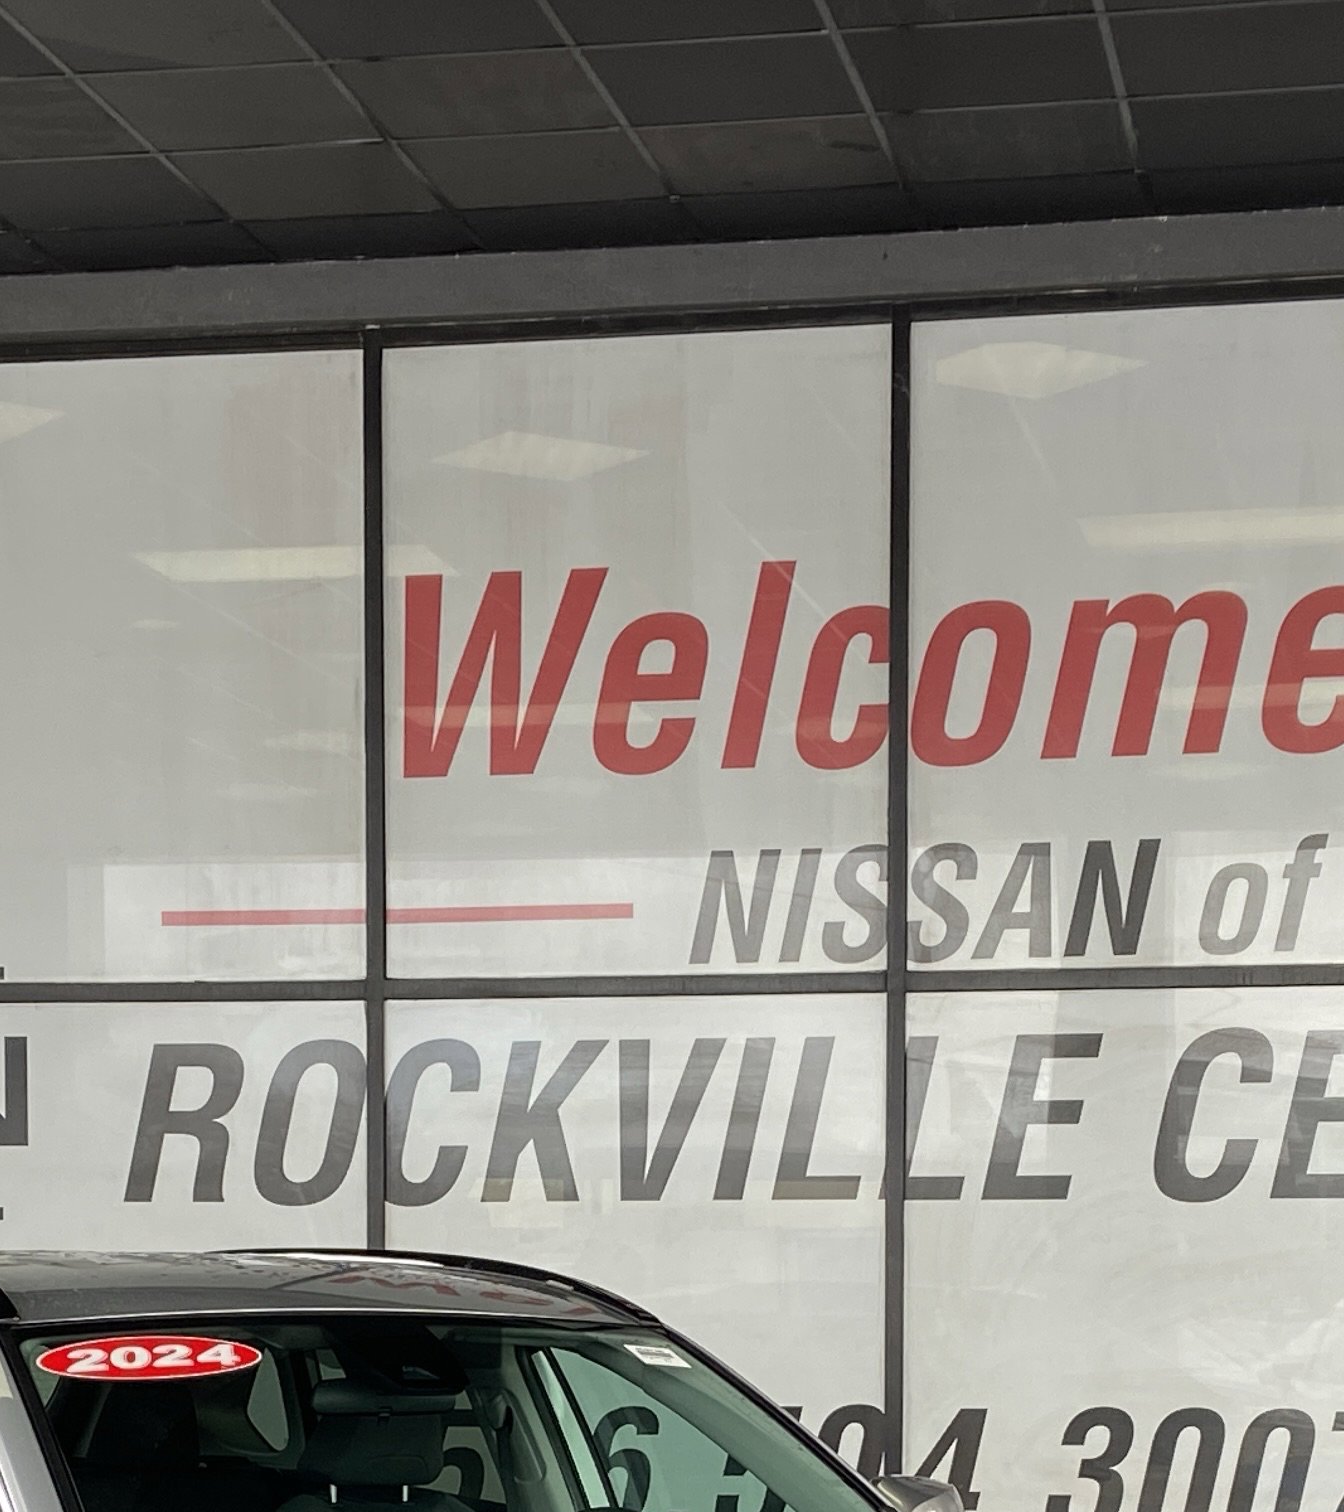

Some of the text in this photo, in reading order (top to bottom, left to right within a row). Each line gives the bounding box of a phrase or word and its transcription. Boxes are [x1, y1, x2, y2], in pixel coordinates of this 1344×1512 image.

[688, 833, 1330, 965] NISSAN of
[123, 1033, 1105, 1208] ROCKVILLE
[65, 1343, 242, 1374] 2024
